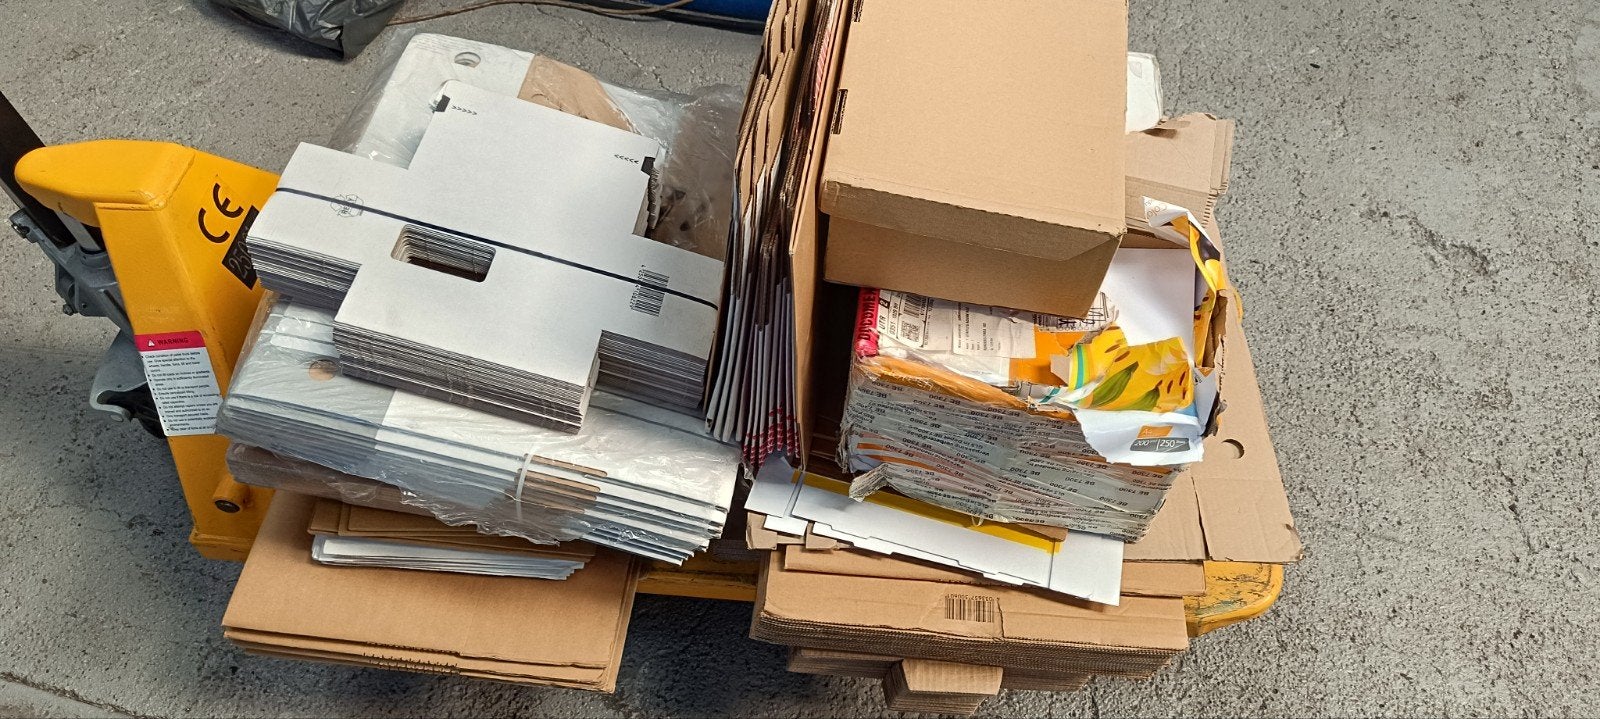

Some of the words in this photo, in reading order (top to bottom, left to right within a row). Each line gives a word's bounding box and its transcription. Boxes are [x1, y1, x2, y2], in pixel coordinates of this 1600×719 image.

[156, 337, 189, 345] WARNING
[970, 408, 989, 419] 7300
[987, 405, 1006, 415] 7300
[1160, 439, 1175, 448] 250
[1131, 468, 1149, 477] 7300
[1048, 481, 1066, 489] 7300
